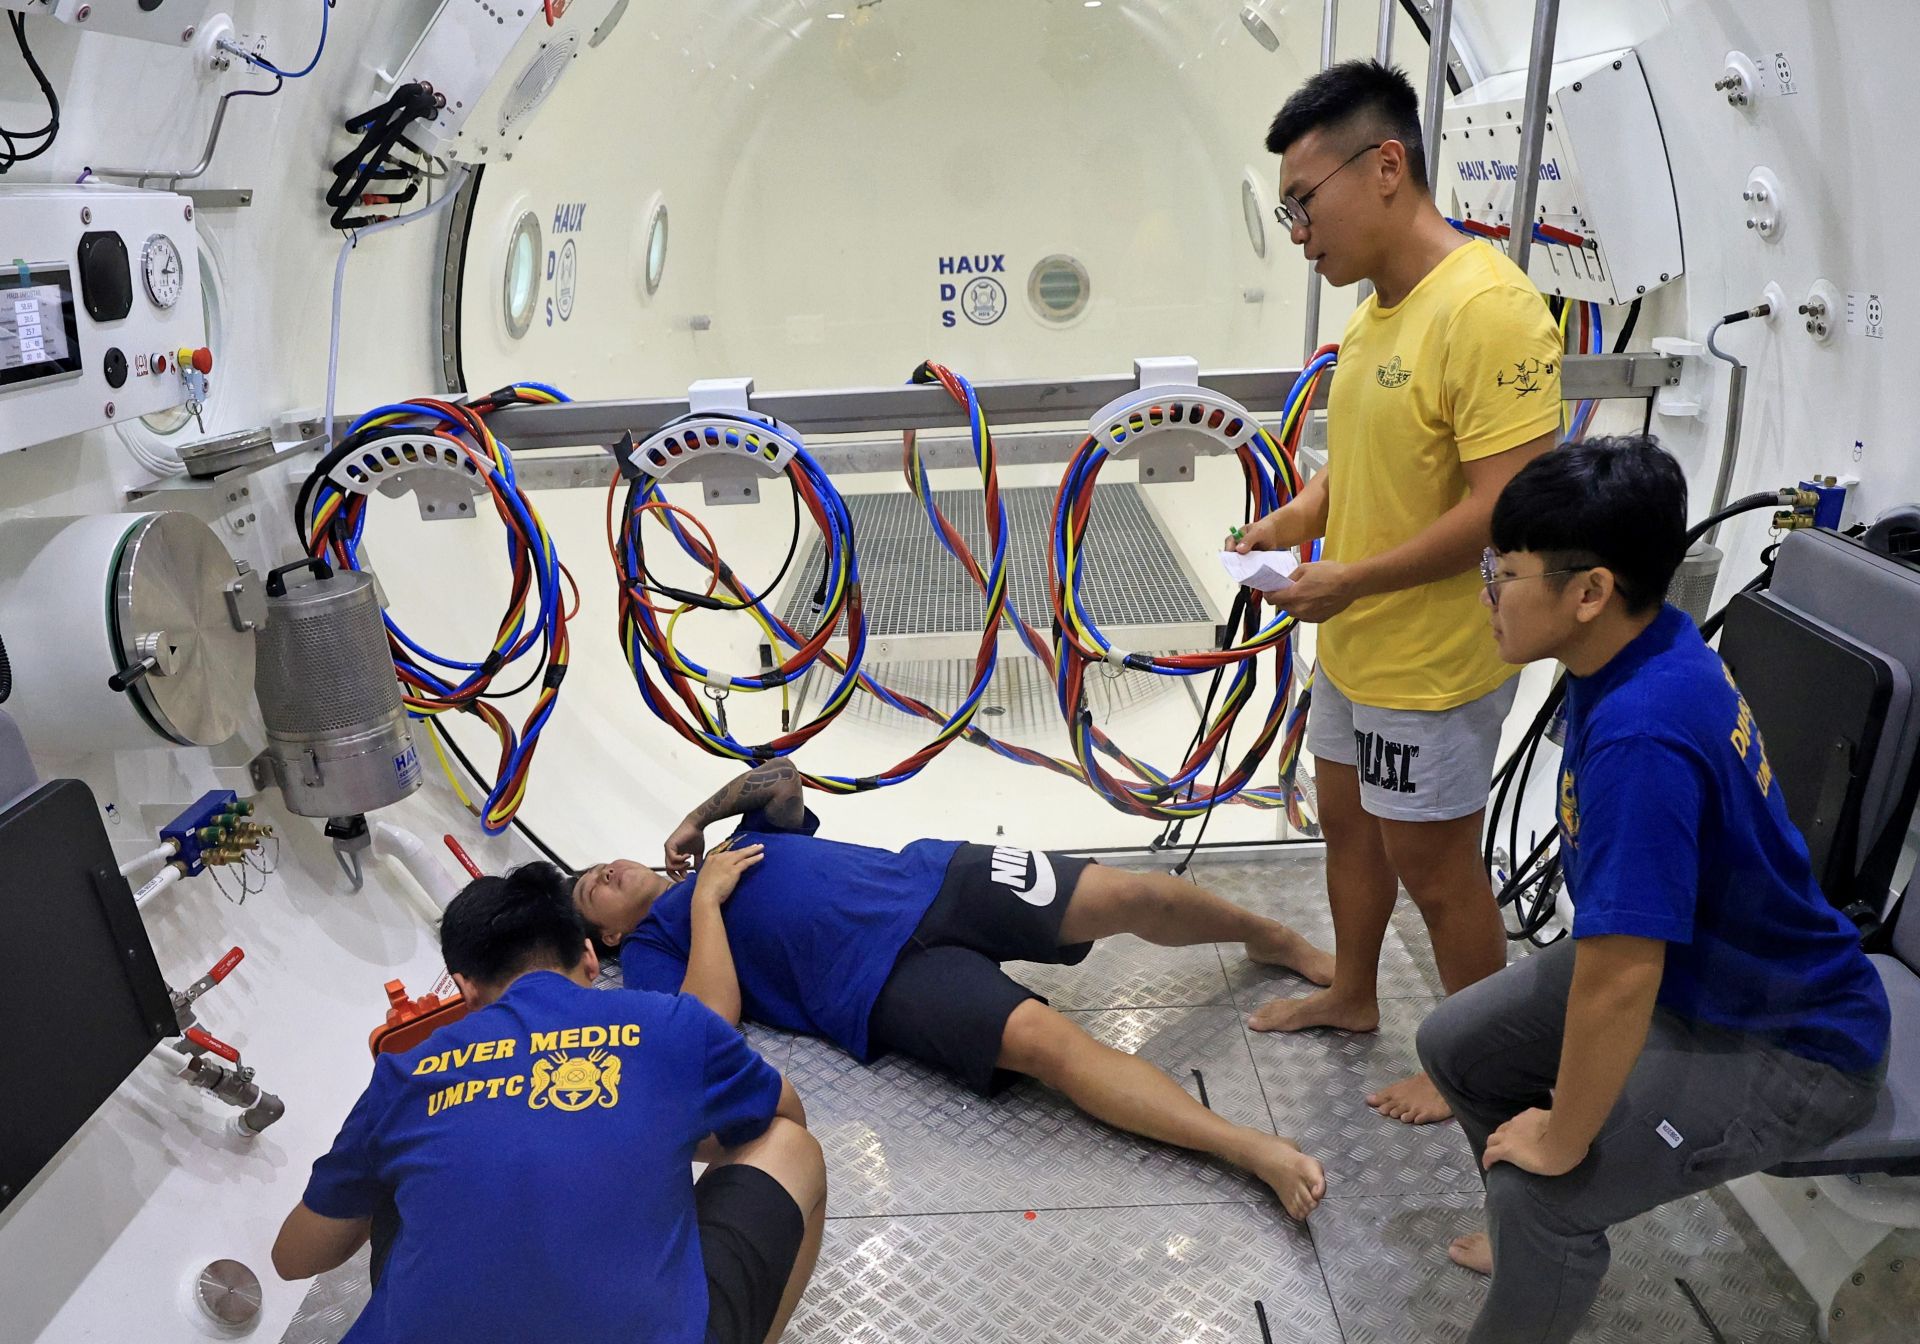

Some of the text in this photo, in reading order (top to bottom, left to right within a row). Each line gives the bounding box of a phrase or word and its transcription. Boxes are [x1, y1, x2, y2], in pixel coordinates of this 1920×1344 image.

[1457, 158, 1561, 181] HAUX-Divenel
[552, 203, 586, 234] HAUX
[547, 250, 556, 281] D
[938, 254, 1006, 275] HAUX
[940, 283, 957, 301] D
[546, 297, 553, 328] S
[942, 310, 957, 328] S
[434, 973, 450, 994] EMERGENC
[411, 1023, 641, 1076] DIVER MEDIC
[426, 1074, 525, 1117] UMPTC
